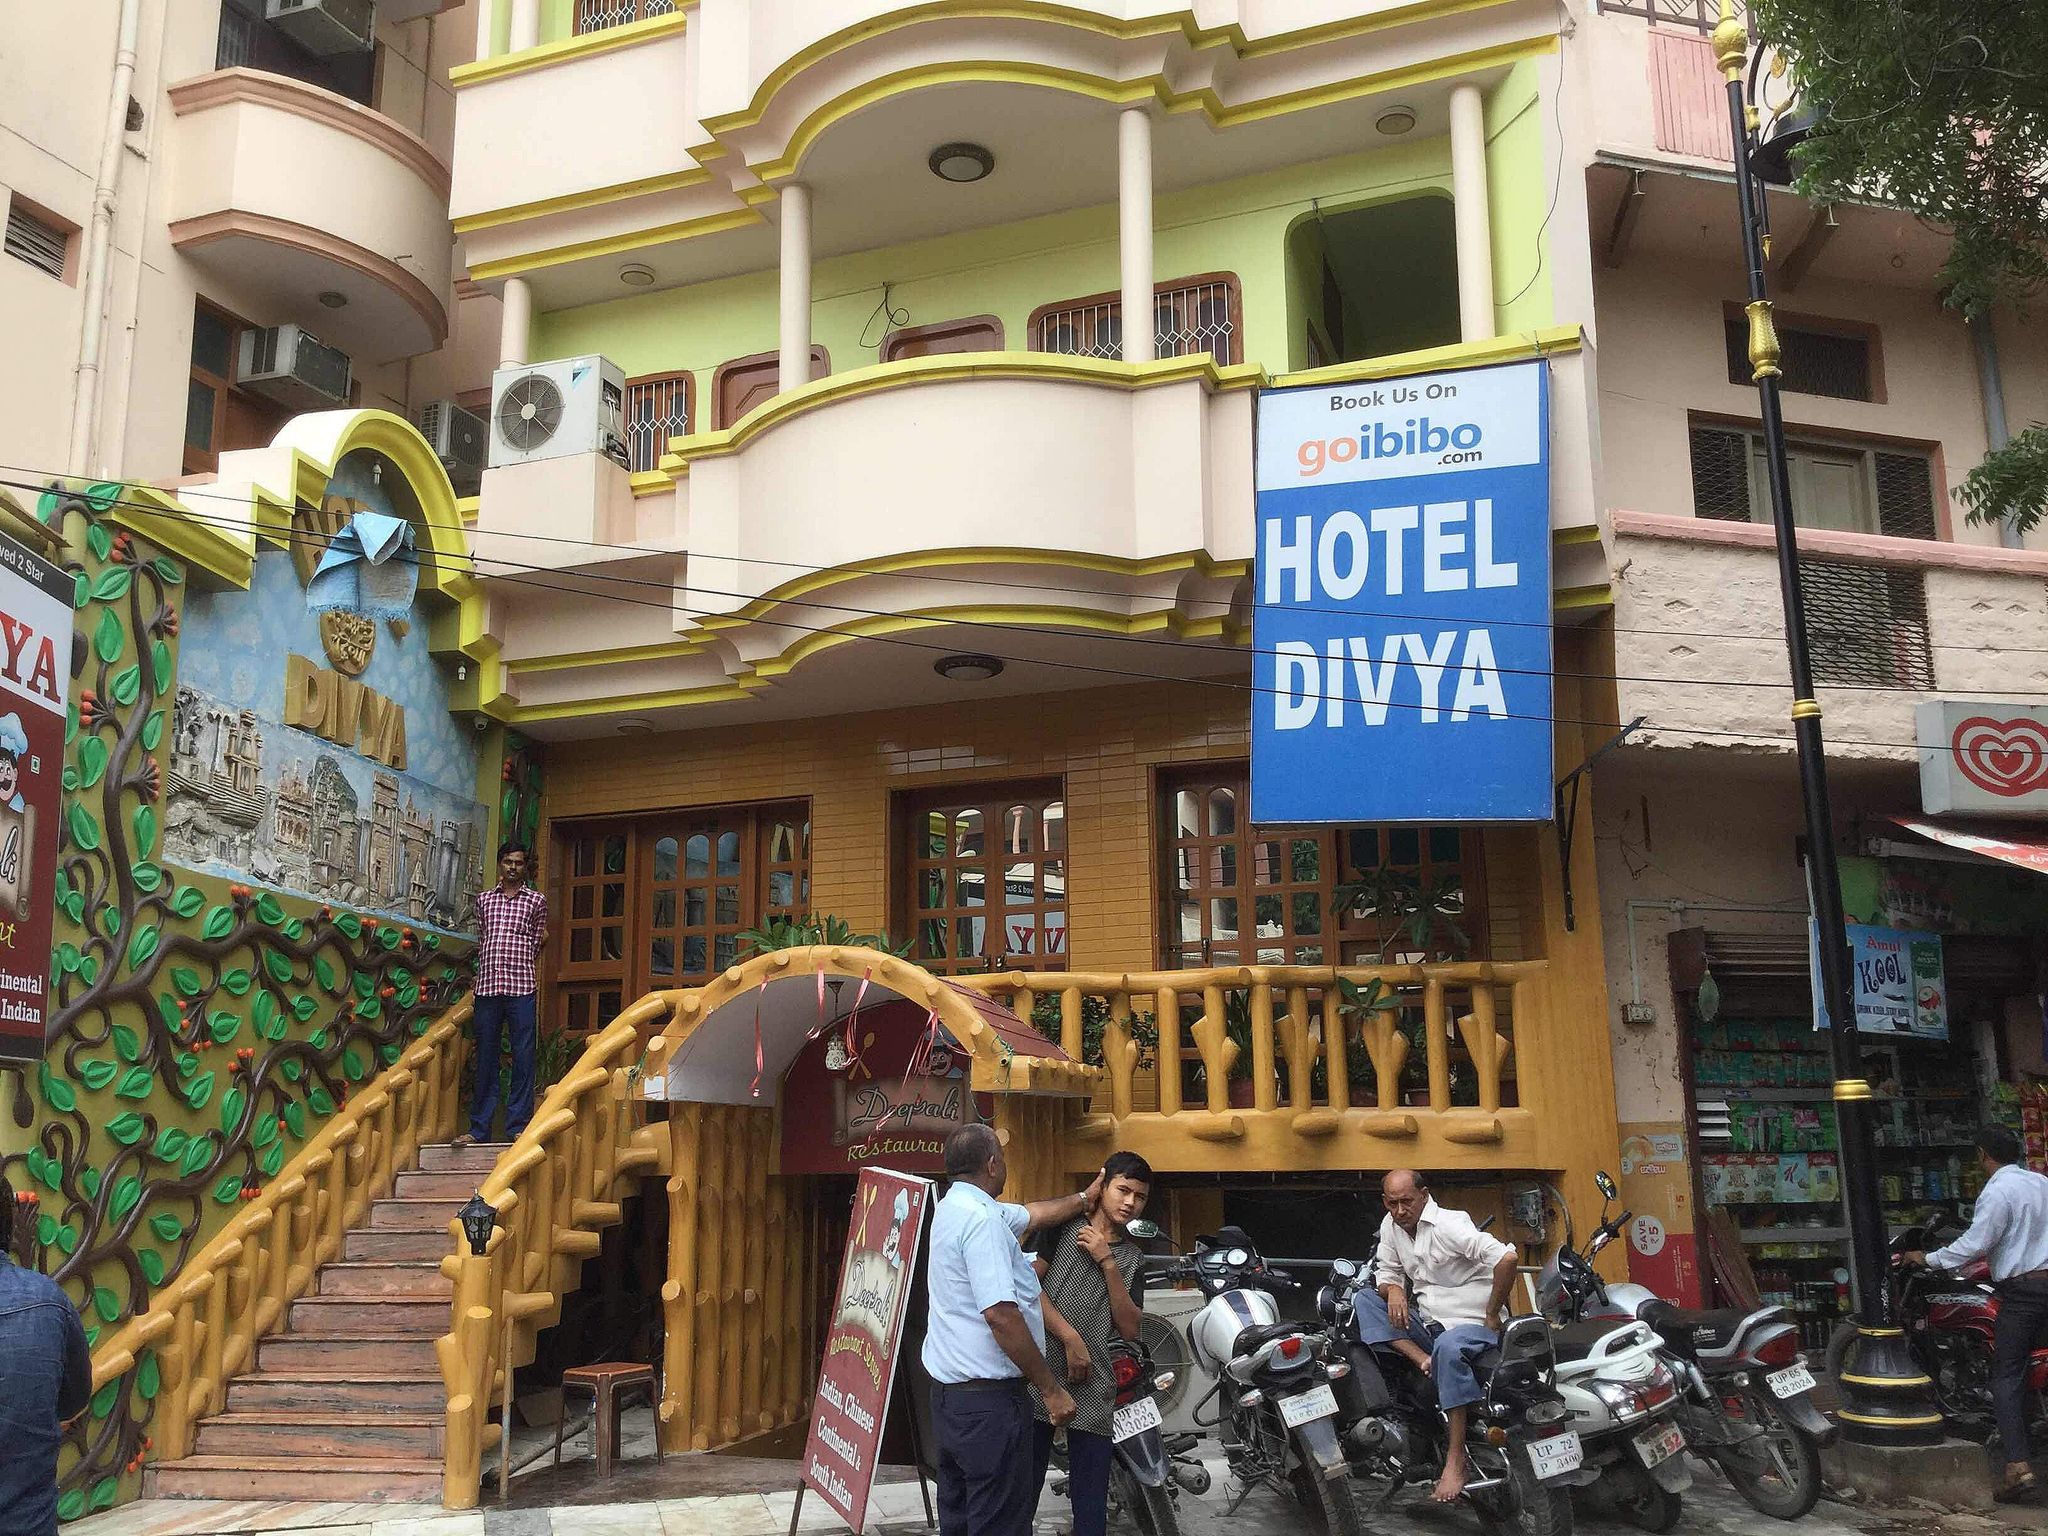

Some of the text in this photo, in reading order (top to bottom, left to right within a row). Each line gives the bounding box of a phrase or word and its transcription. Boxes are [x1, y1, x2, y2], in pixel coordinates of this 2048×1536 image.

[1330, 383, 1457, 411] Book Us On
[1297, 416, 1482, 477] goibibo
[1437, 449, 1483, 466] .com
[1264, 498, 1518, 605] HOTEL
[17, 554, 24, 571] 2
[25, 559, 45, 583] Star
[1274, 628, 1509, 731] DIVYA
[284, 653, 408, 772] DIVYA
[1866, 935, 1904, 952] Amul
[0, 968, 43, 995] inental
[1857, 953, 1907, 995] KOOL
[1, 998, 41, 1023] Indian
[851, 1086, 960, 1127] Deepali
[847, 1138, 945, 1162] Restaura
[1638, 1220, 1648, 1251] SAVE
[1774, 1372, 1788, 1384] UP
[819, 1374, 875, 1435] Indian, Chinese
[816, 1415, 862, 1472] Continental &
[1536, 1438, 1574, 1458] UP 72
[809, 1453, 853, 1512] South Indian
[1540, 1462, 1548, 1474] P
